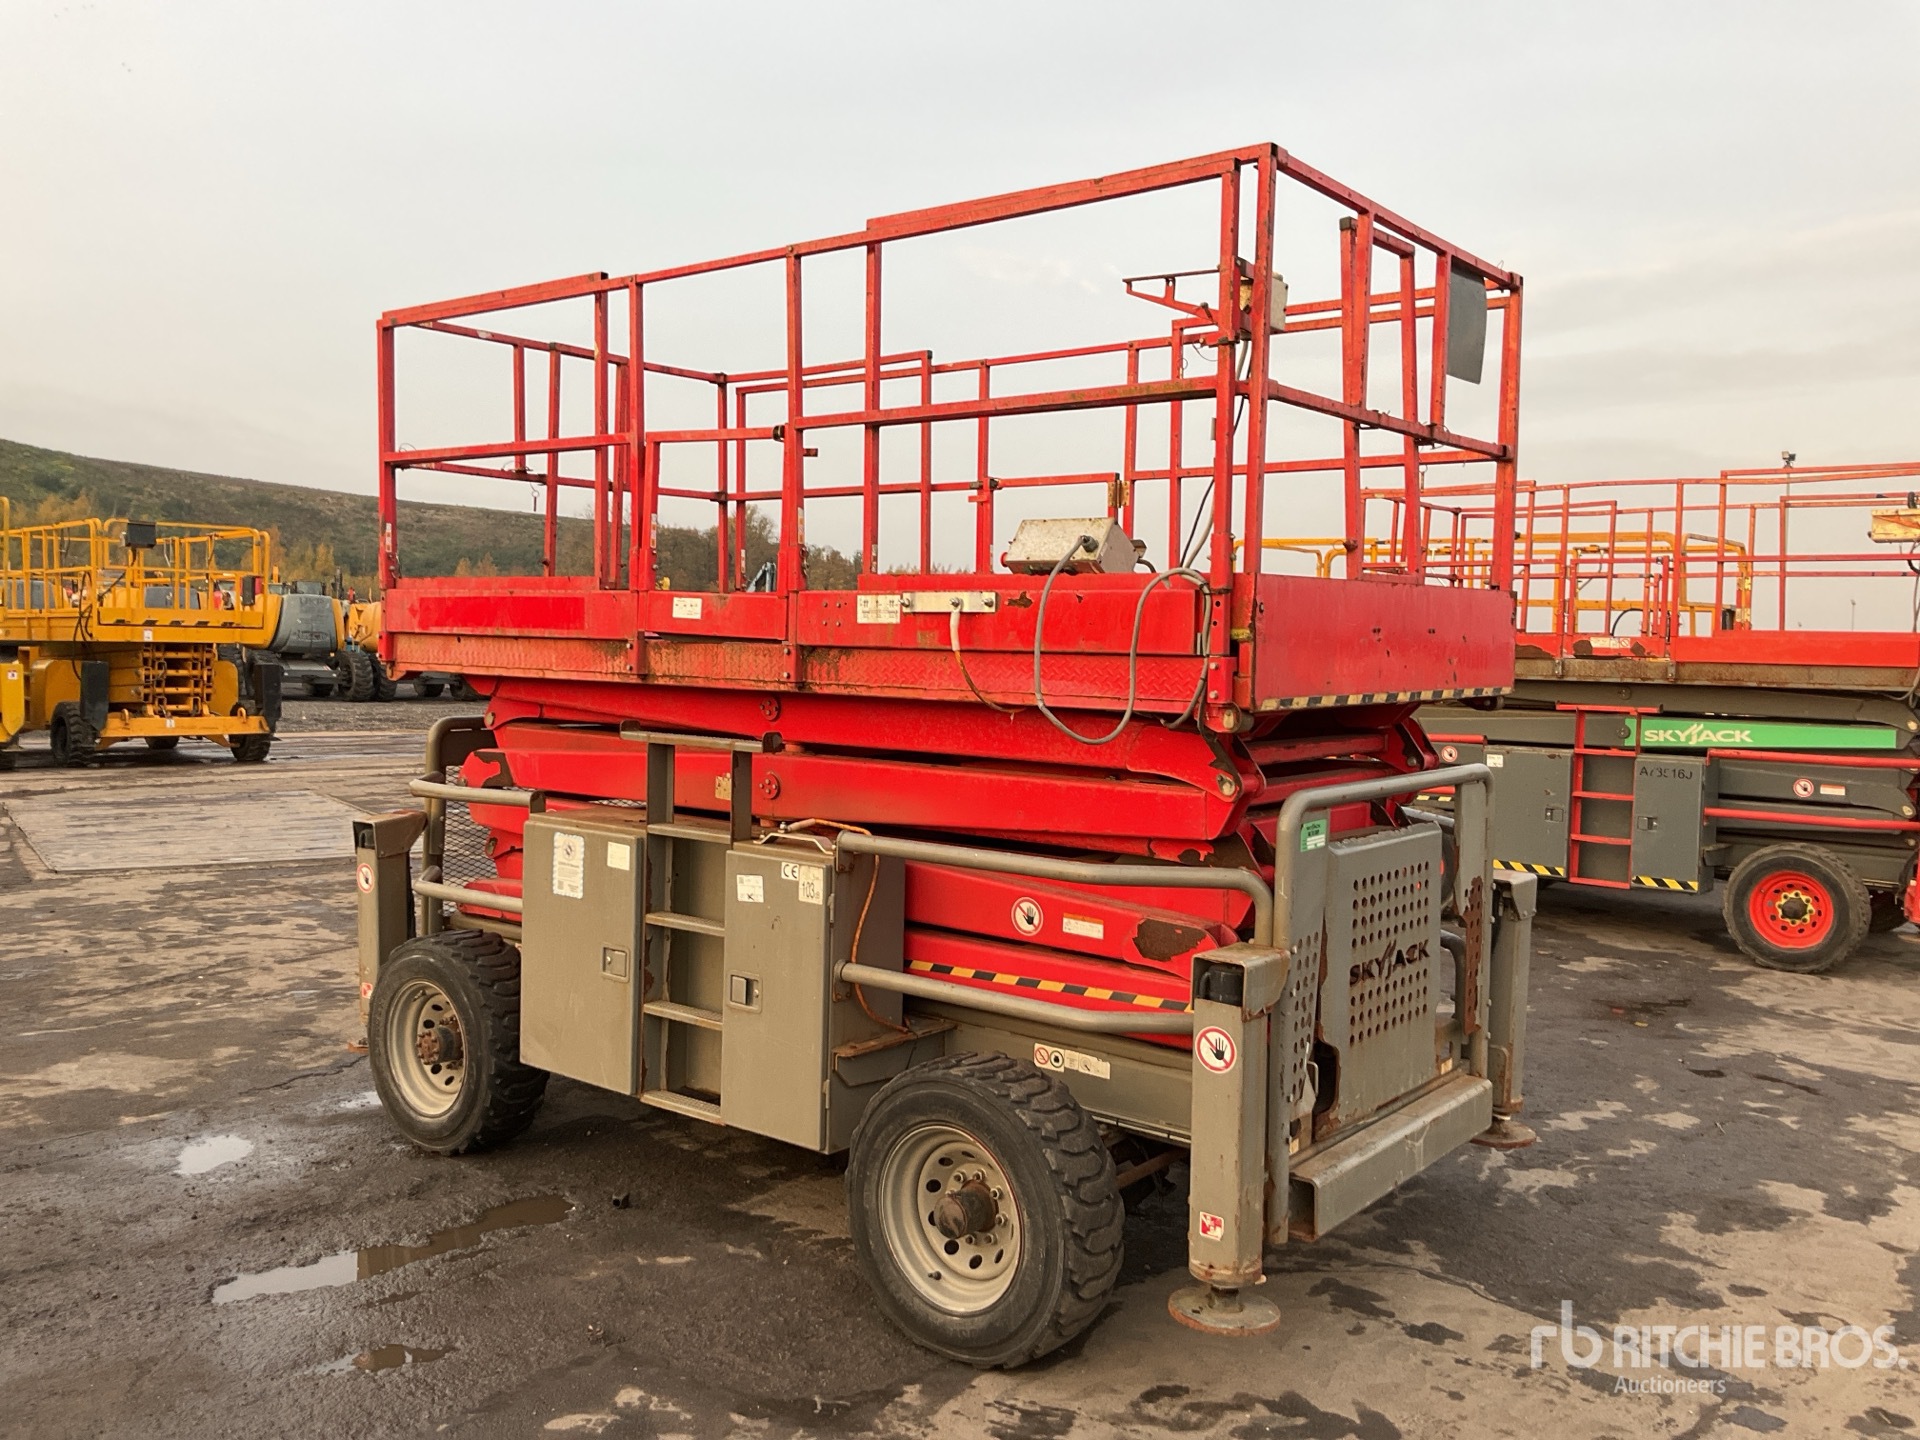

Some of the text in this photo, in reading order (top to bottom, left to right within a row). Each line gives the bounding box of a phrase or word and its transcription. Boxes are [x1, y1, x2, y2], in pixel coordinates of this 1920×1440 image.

[1644, 723, 1754, 745] SKYJACK
[783, 864, 798, 879] CE
[1349, 939, 1430, 987] SKYJACK
